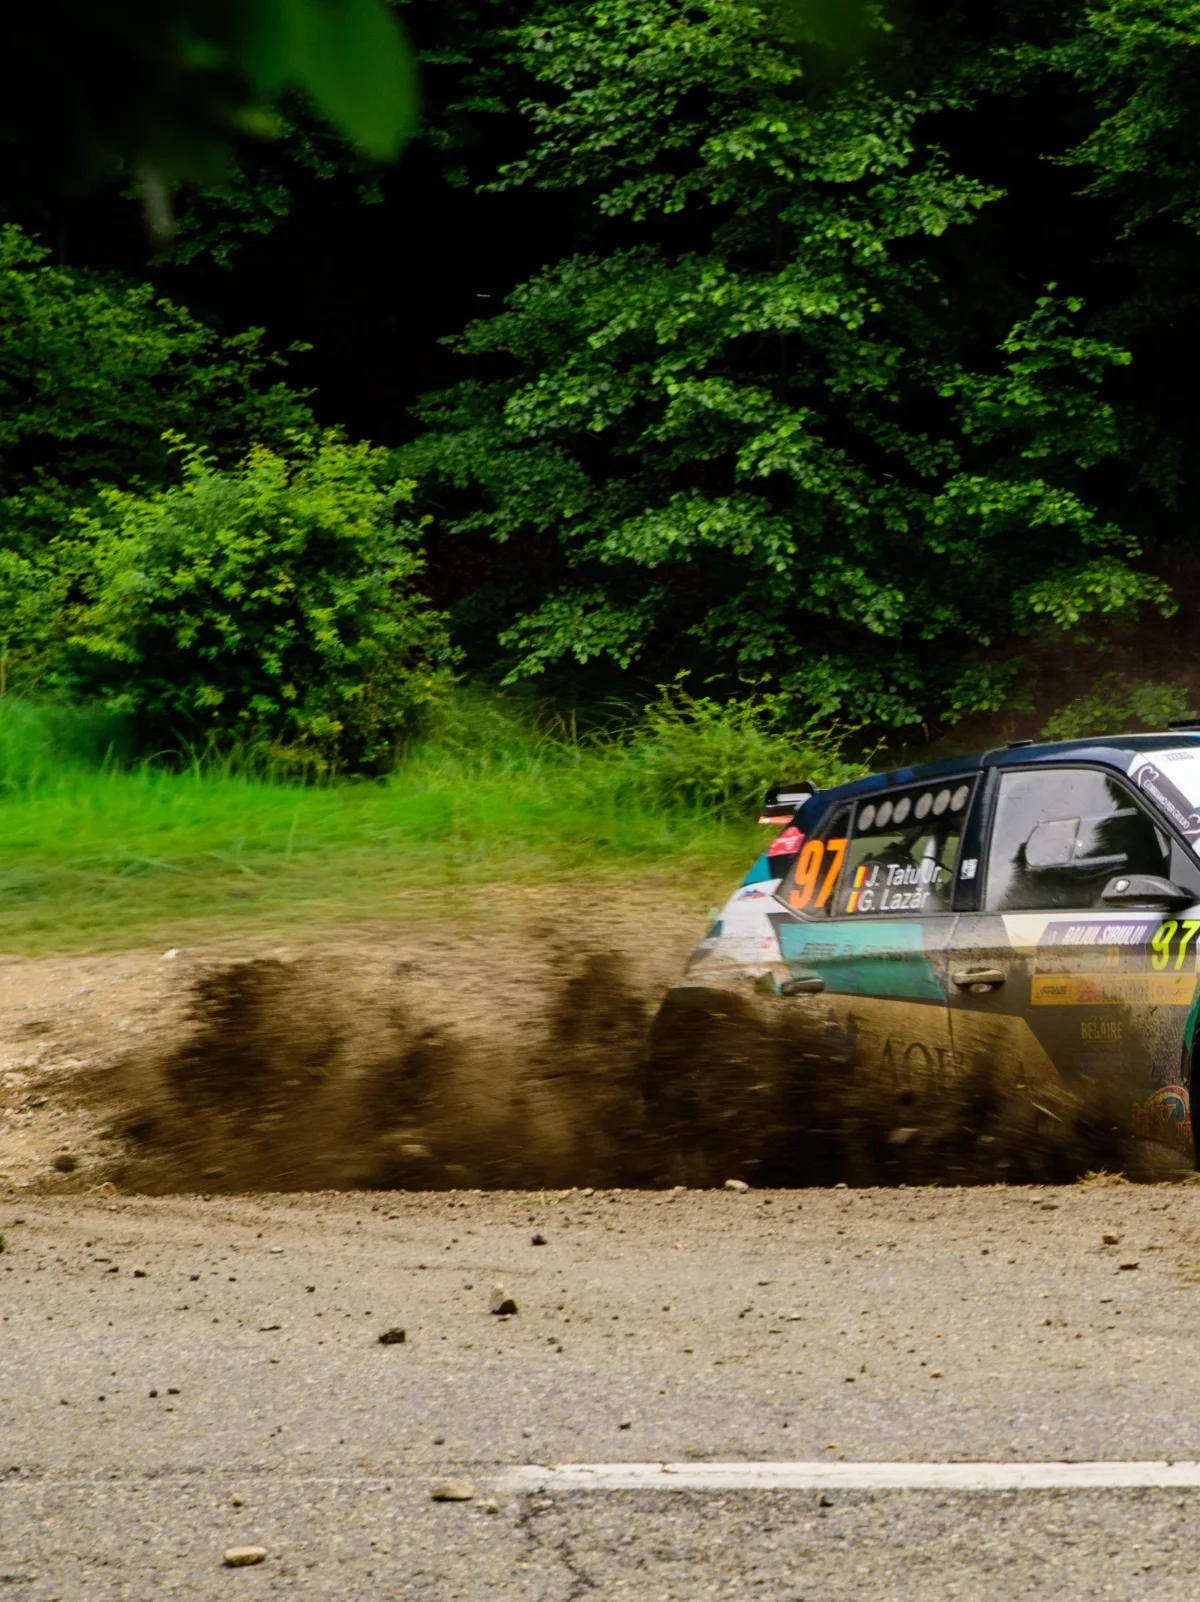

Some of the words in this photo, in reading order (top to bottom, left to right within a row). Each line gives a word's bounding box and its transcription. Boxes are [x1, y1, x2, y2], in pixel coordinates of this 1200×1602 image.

[789, 838, 848, 910] 97
[886, 864, 919, 886] Tatu
[857, 889, 875, 911] G.
[1080, 1021, 1124, 1040] BELAIRE
